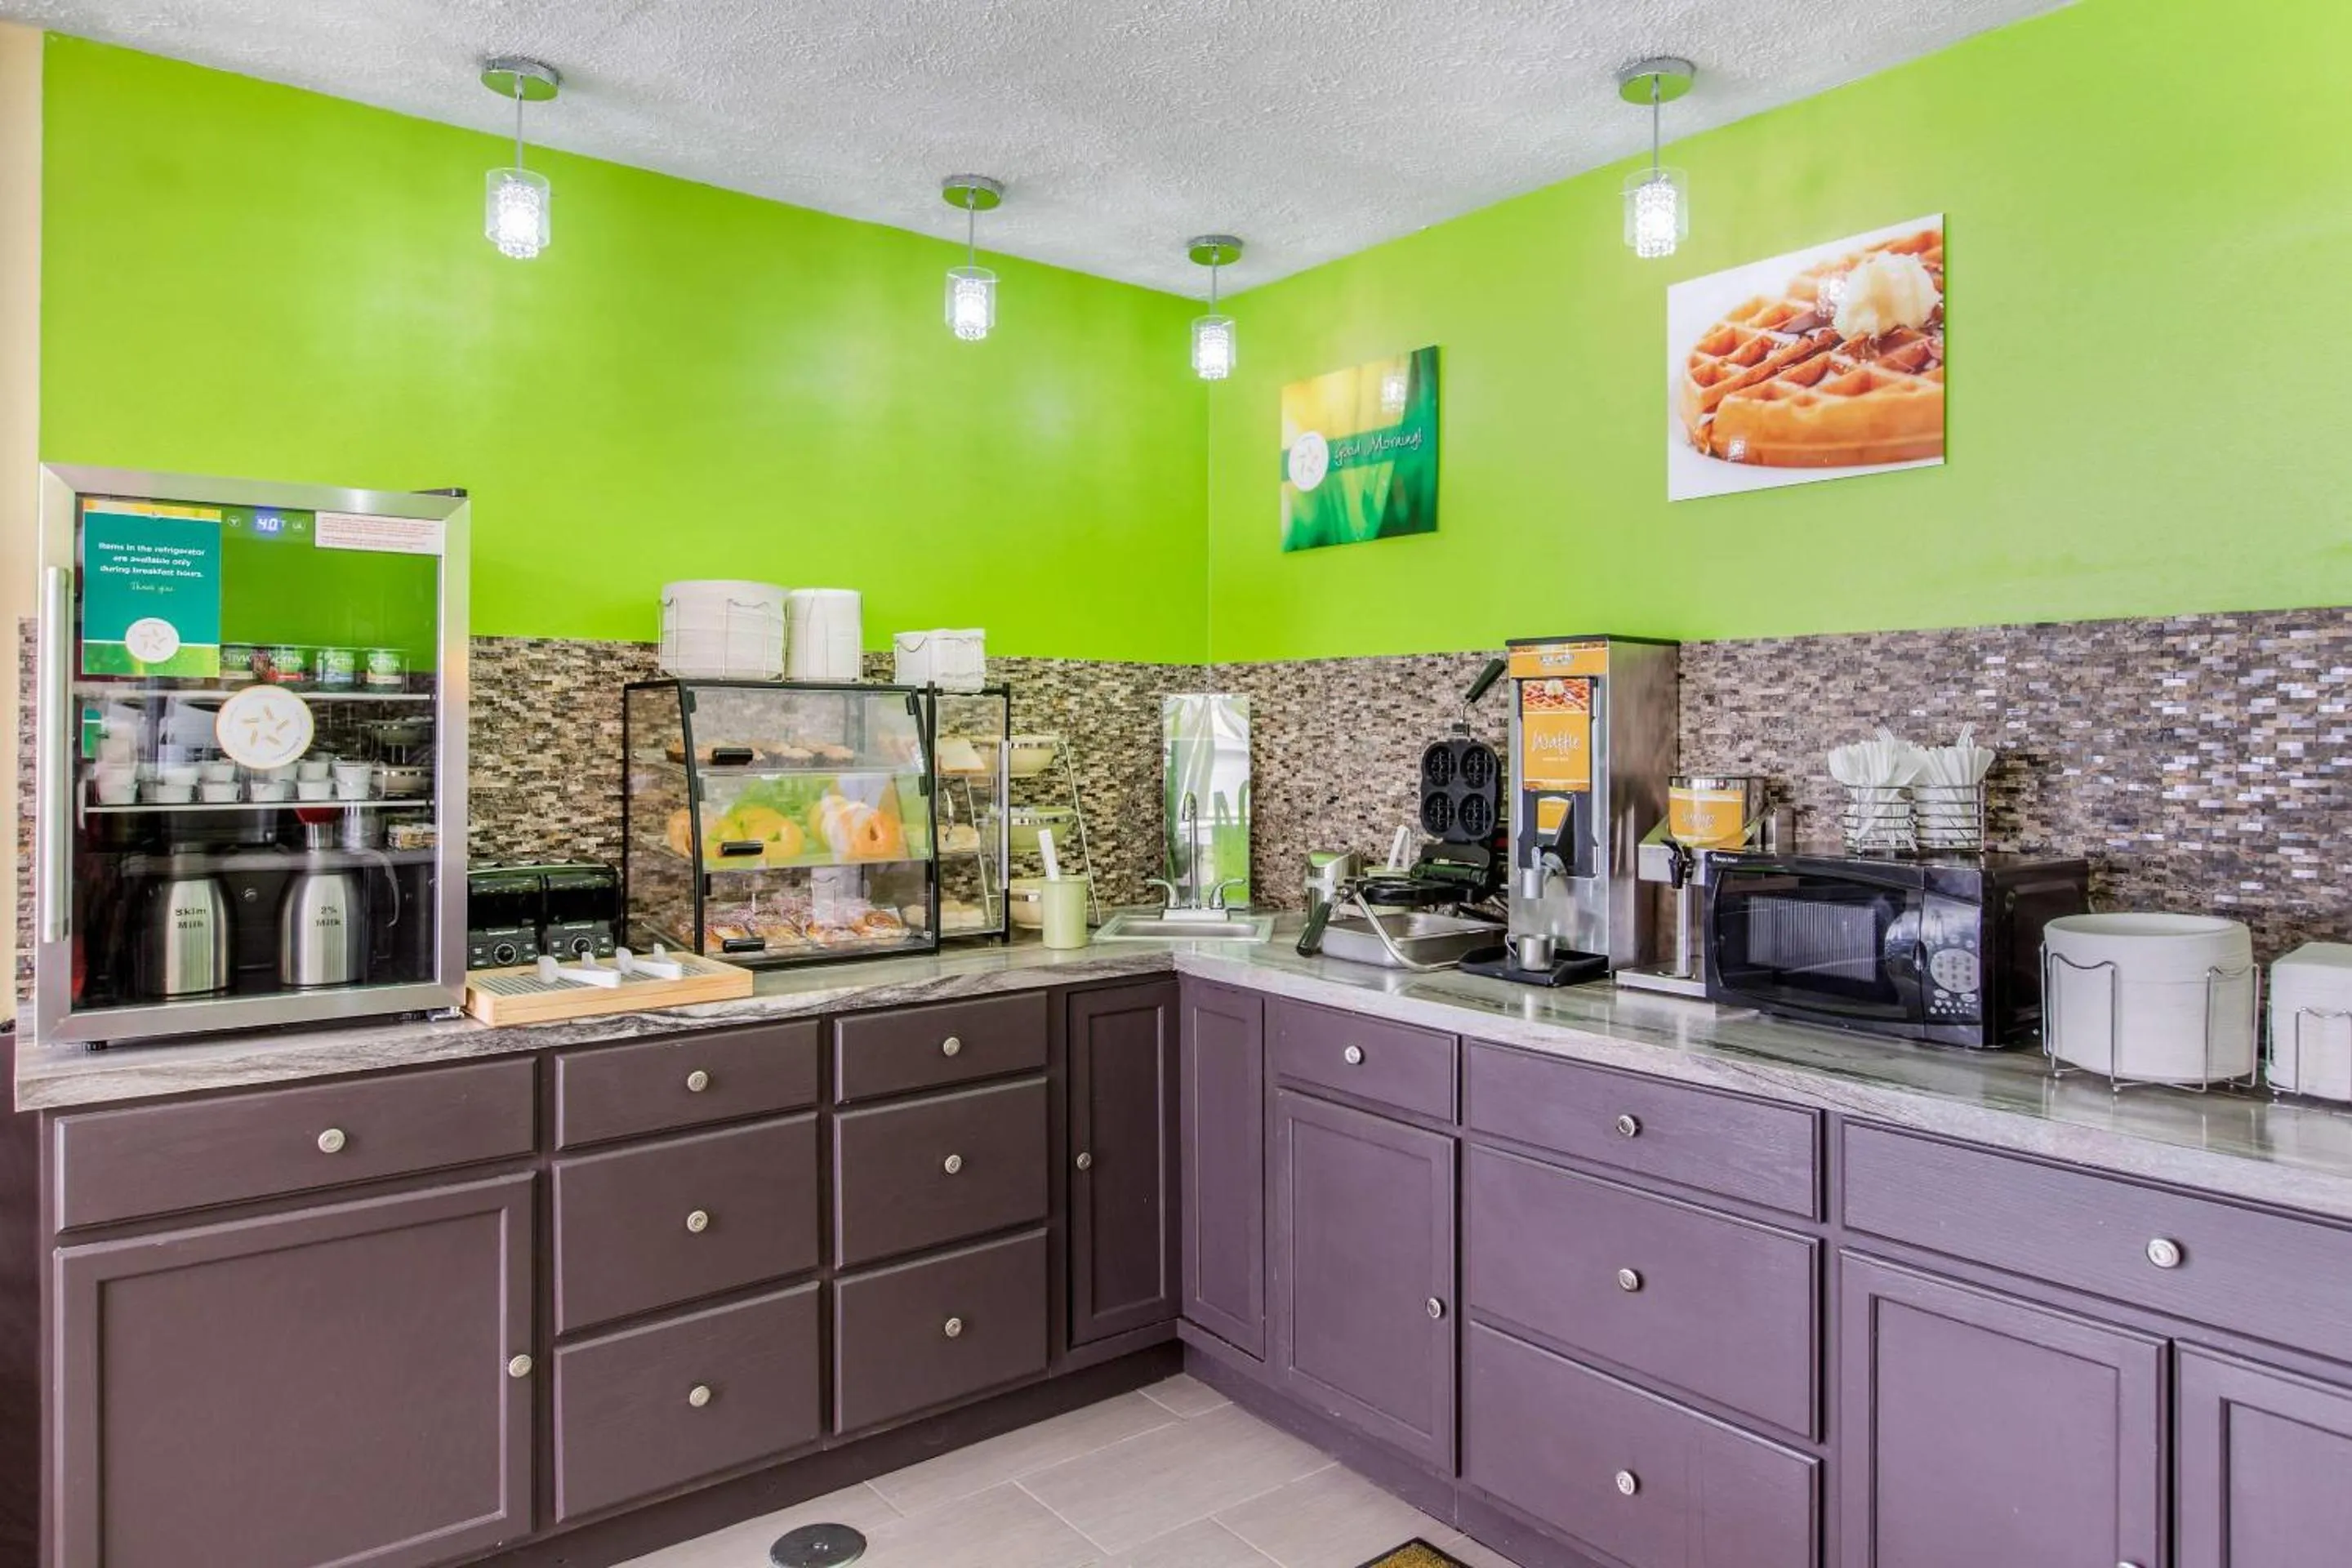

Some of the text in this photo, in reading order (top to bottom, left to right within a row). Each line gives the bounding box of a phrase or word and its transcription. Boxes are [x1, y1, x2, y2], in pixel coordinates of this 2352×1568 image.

[1334, 426, 1422, 466] Good Morning!
[256, 517, 278, 531] 40
[98, 542, 124, 550] Items
[137, 545, 153, 553] the
[154, 546, 205, 556] refrigerator
[131, 556, 170, 565] available
[172, 559, 191, 568] only
[100, 565, 131, 575] during
[132, 567, 175, 577] breakfast
[1530, 727, 1581, 755] Waffle
[176, 907, 206, 916] Skim
[321, 906, 337, 915] 2%
[177, 920, 203, 929] Milk
[316, 919, 341, 927] Milk
